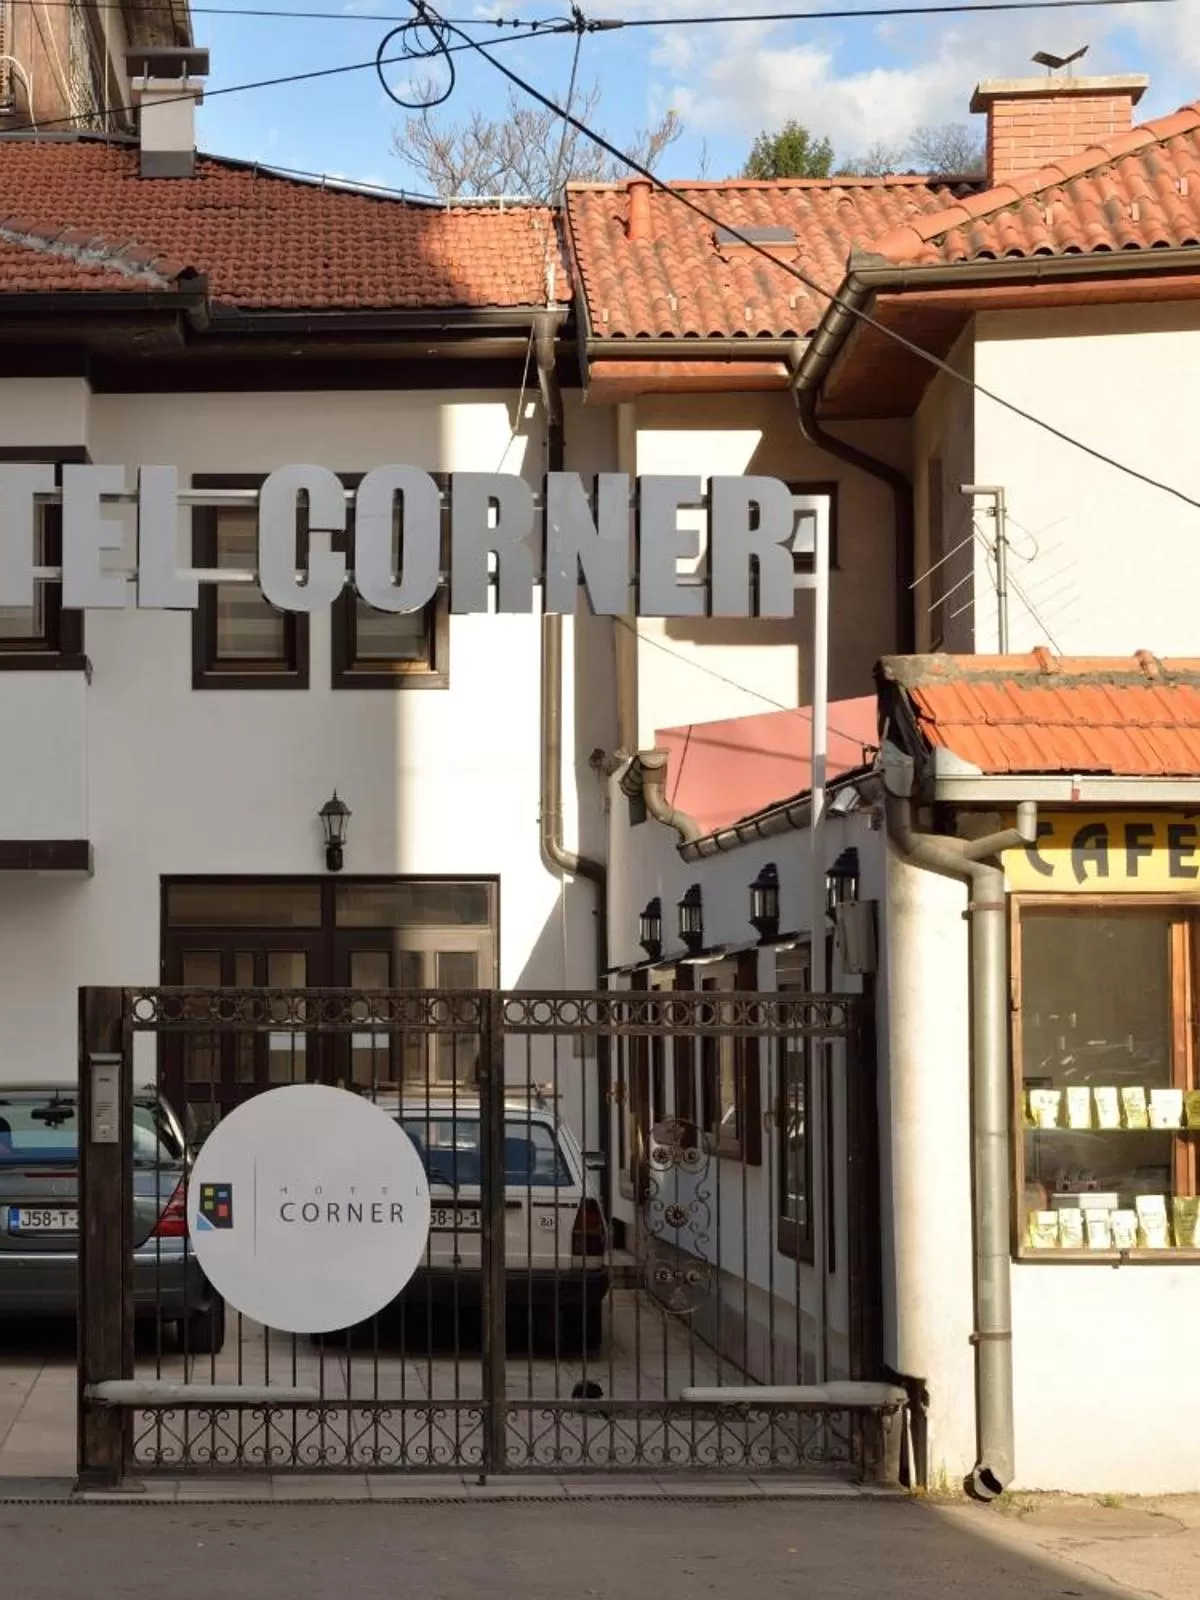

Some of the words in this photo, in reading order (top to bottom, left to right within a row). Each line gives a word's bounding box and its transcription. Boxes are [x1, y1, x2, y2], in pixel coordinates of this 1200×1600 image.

[259, 464, 796, 618] CORNER
[279, 1185, 423, 1197] HOTEL
[280, 1202, 404, 1223] CORNER
